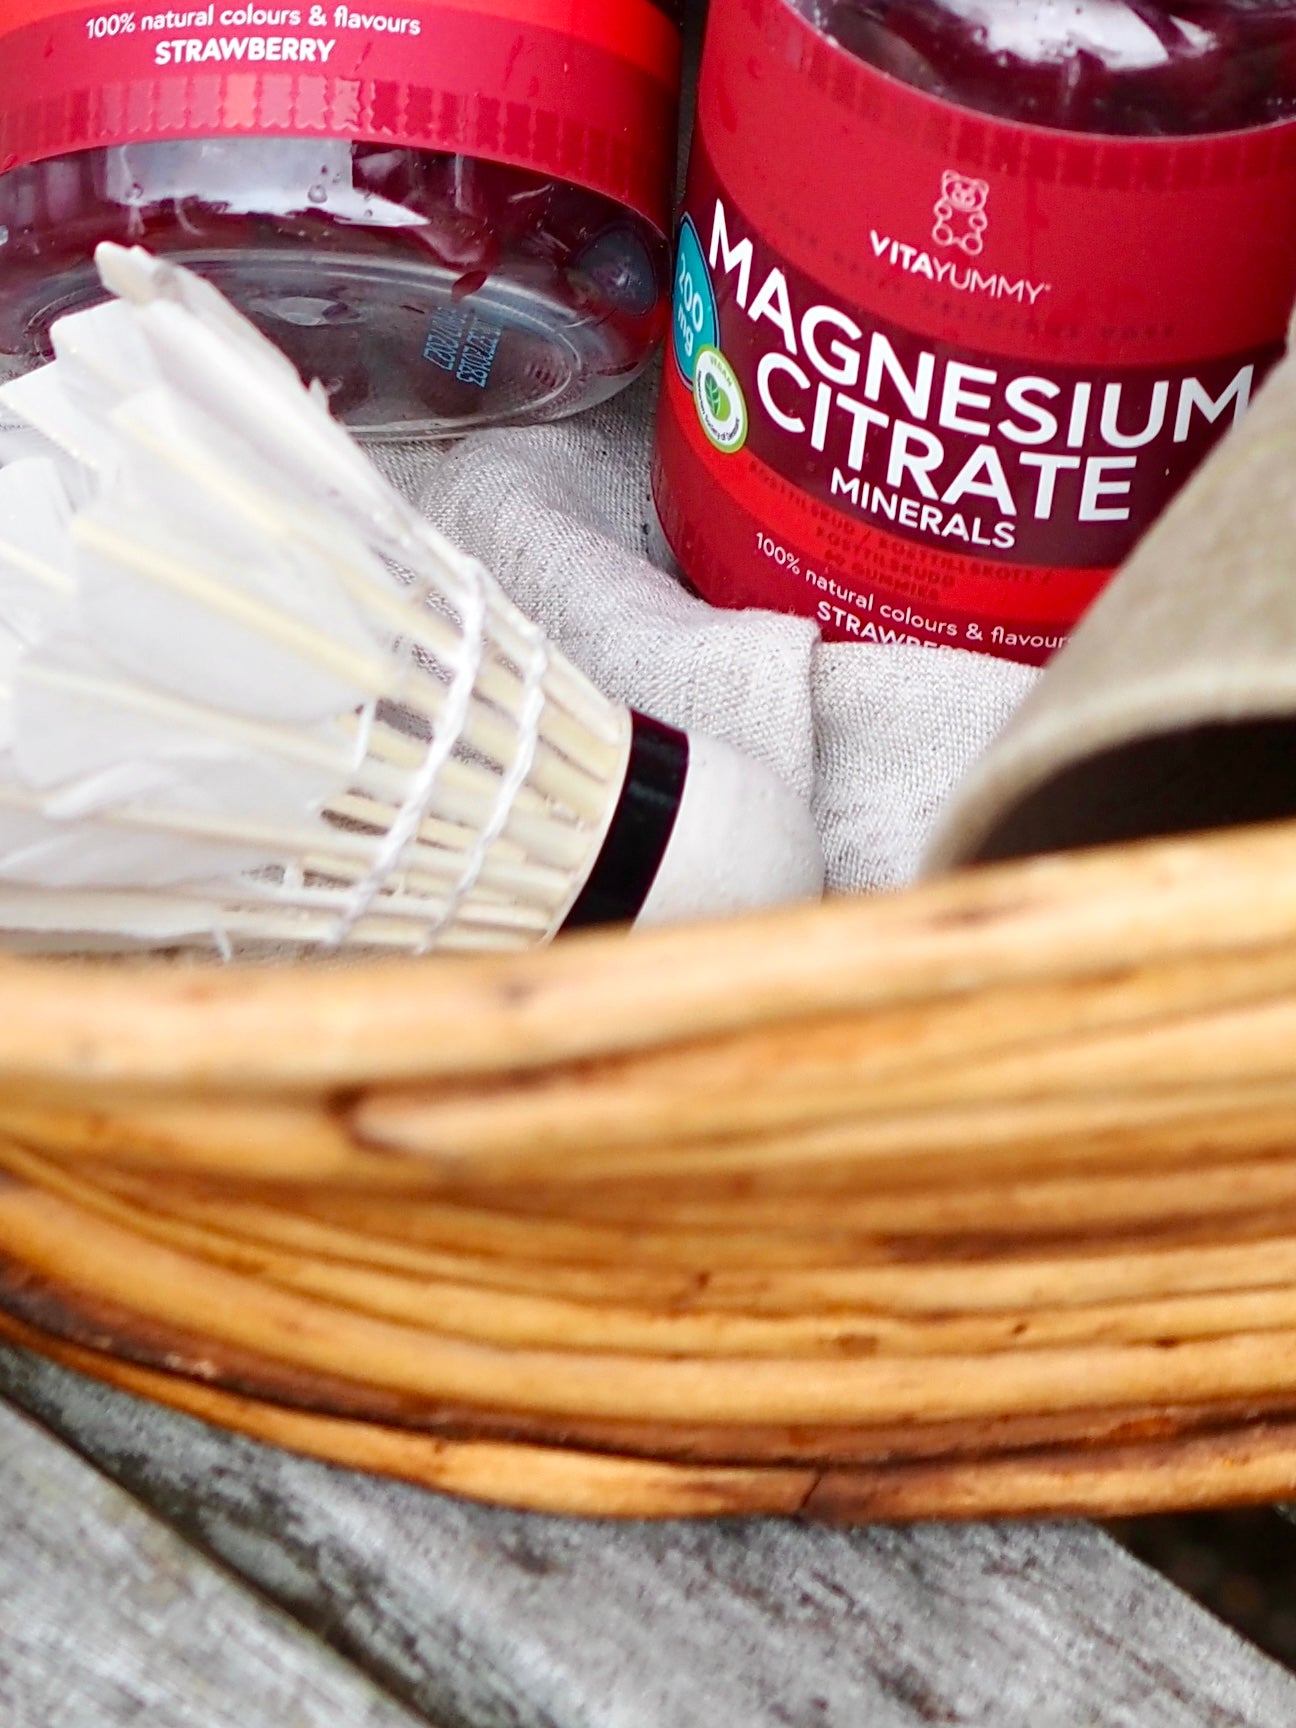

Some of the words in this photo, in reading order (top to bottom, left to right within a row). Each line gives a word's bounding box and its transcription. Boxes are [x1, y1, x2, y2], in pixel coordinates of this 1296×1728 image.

[85, 11, 135, 40] 100%
[141, 4, 214, 31] natural
[219, 3, 301, 27] colours
[309, 5, 328, 27] &
[334, 6, 421, 36] flavours
[154, 37, 336, 65] STRAWBERRY
[679, 252, 704, 333] 200
[870, 229, 1046, 305] VITAYUMMY
[678, 303, 694, 357] mg
[708, 198, 1255, 449] MAGNESIUM
[756, 351, 1138, 522] CITRATE
[831, 467, 1016, 549] MINERALS
[756, 532, 800, 575] 100%
[806, 570, 874, 611] natural
[880, 602, 957, 637] colours
[966, 623, 983, 642] &
